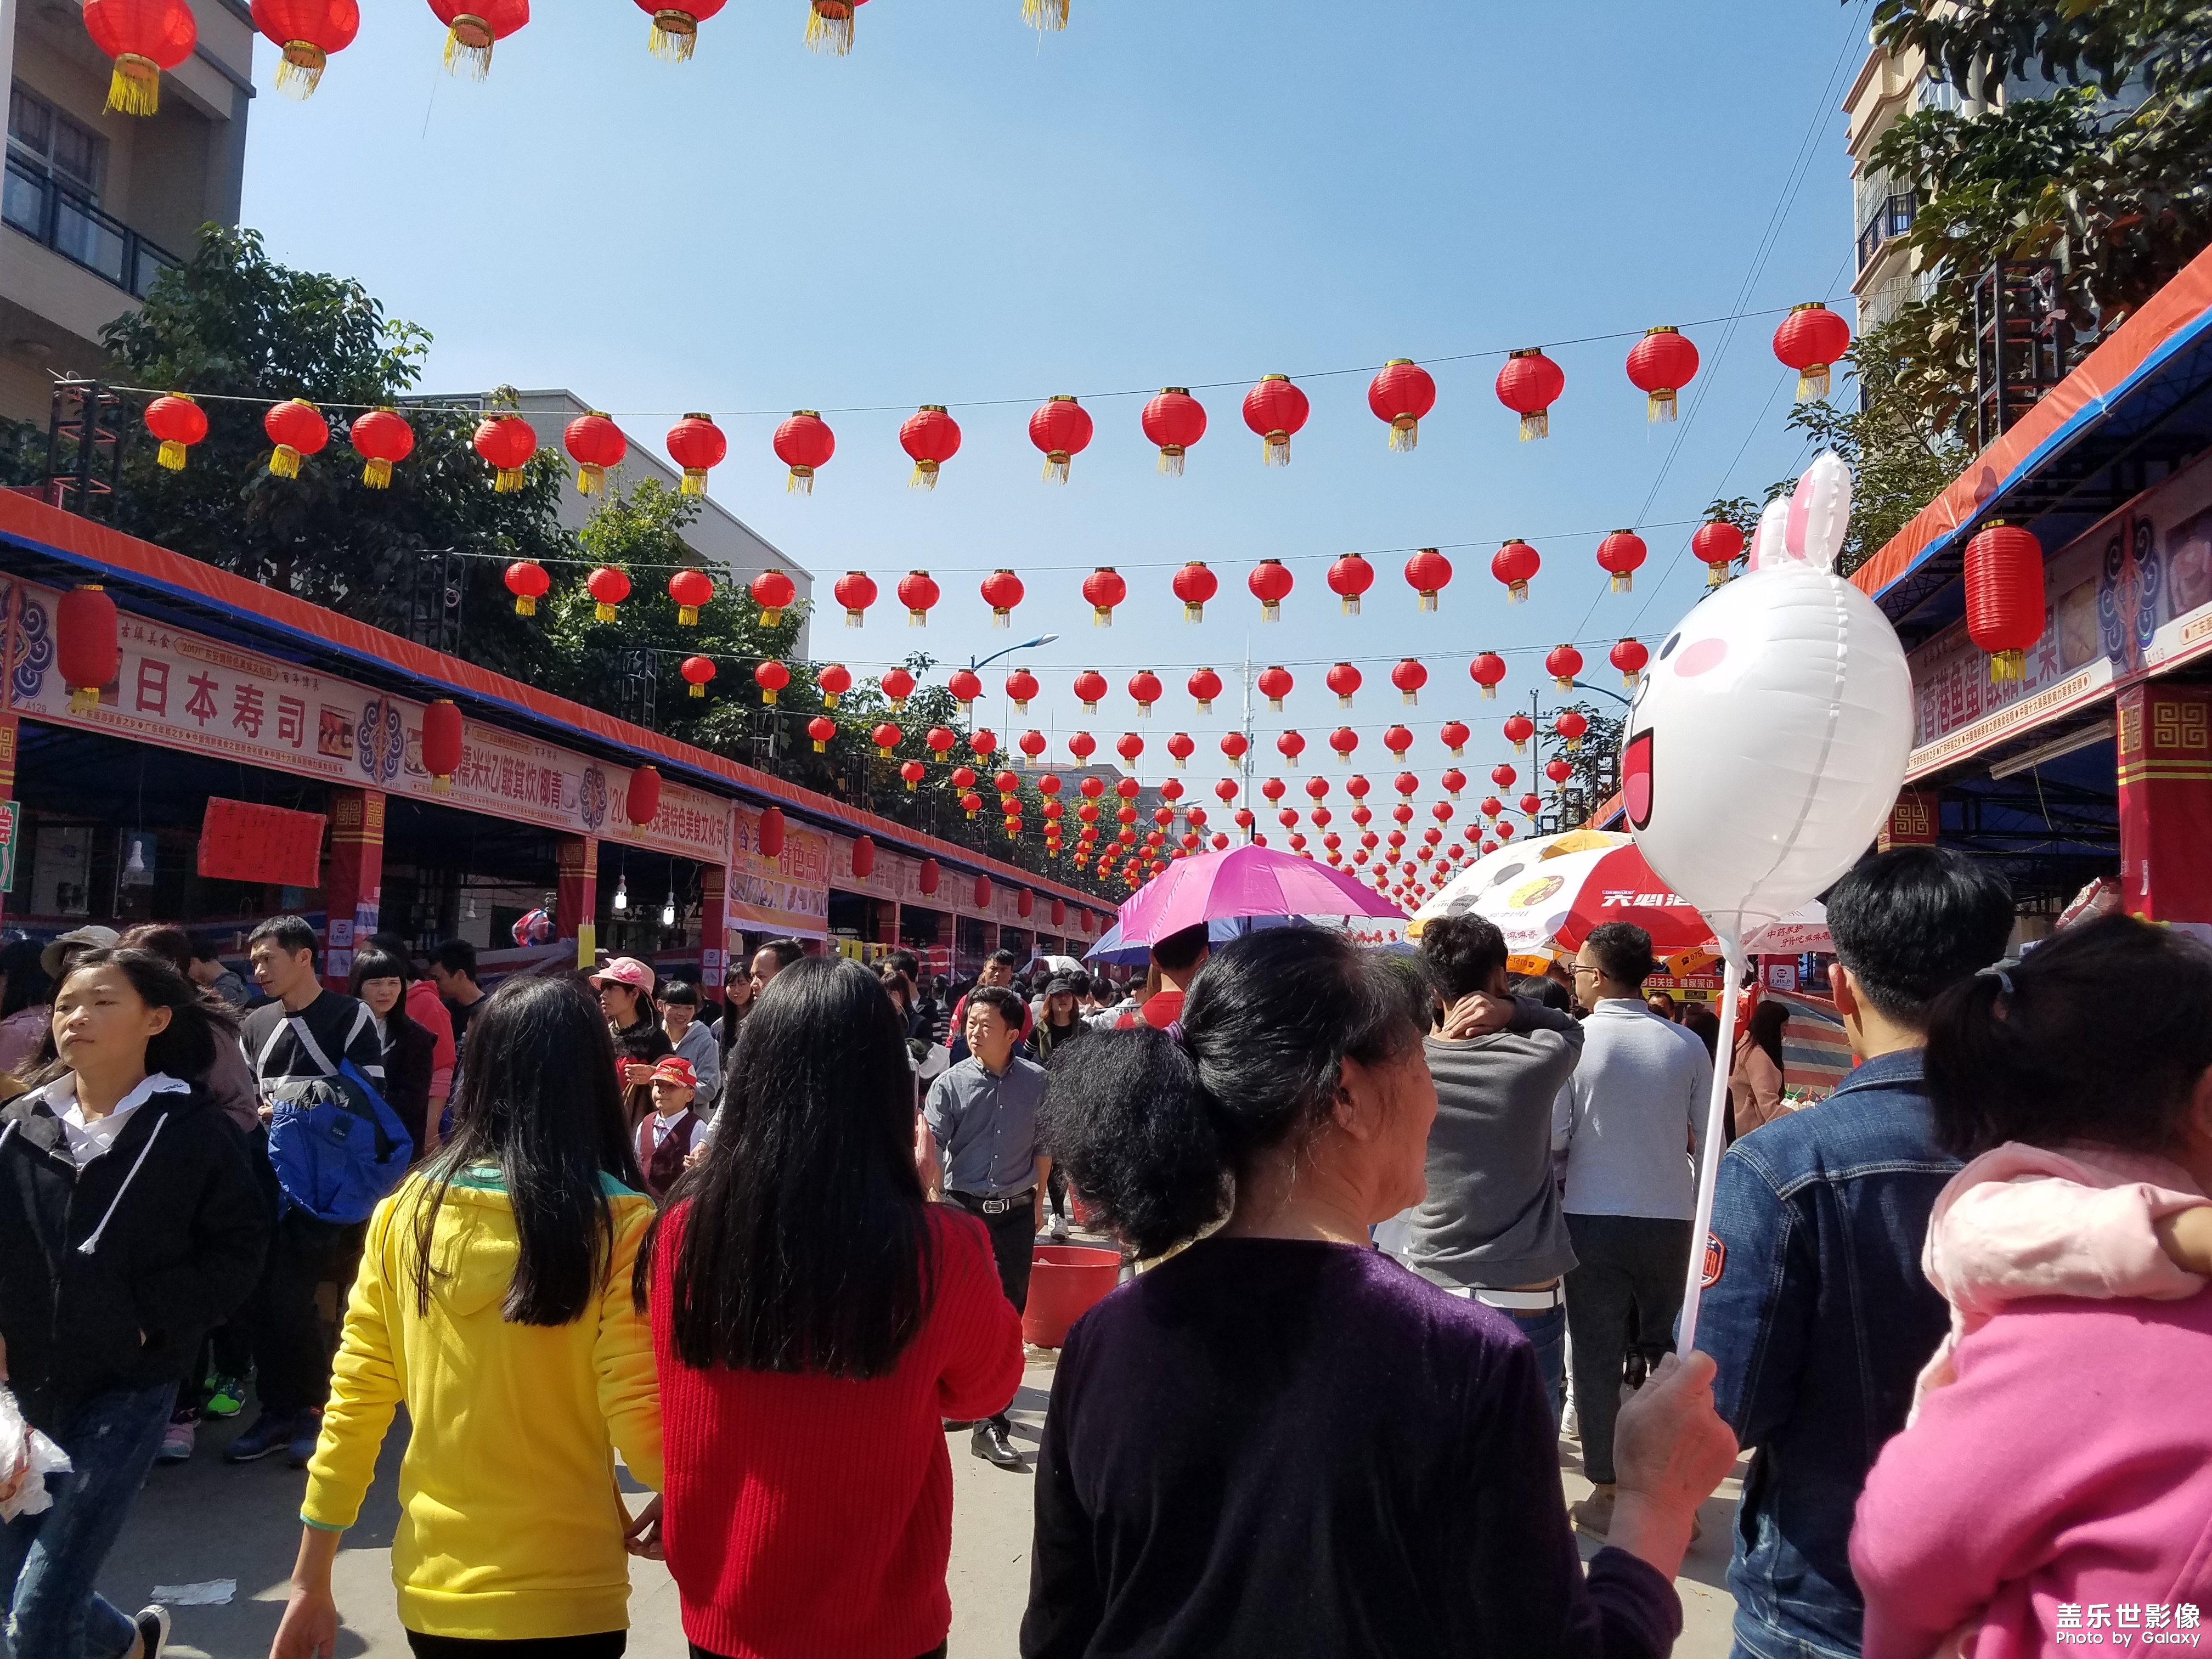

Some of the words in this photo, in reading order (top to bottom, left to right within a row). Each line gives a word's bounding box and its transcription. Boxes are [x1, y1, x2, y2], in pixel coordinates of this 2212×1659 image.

[136, 657, 305, 748] 日本寿司
[1503, 930, 1538, 939] 嘛嘛香
